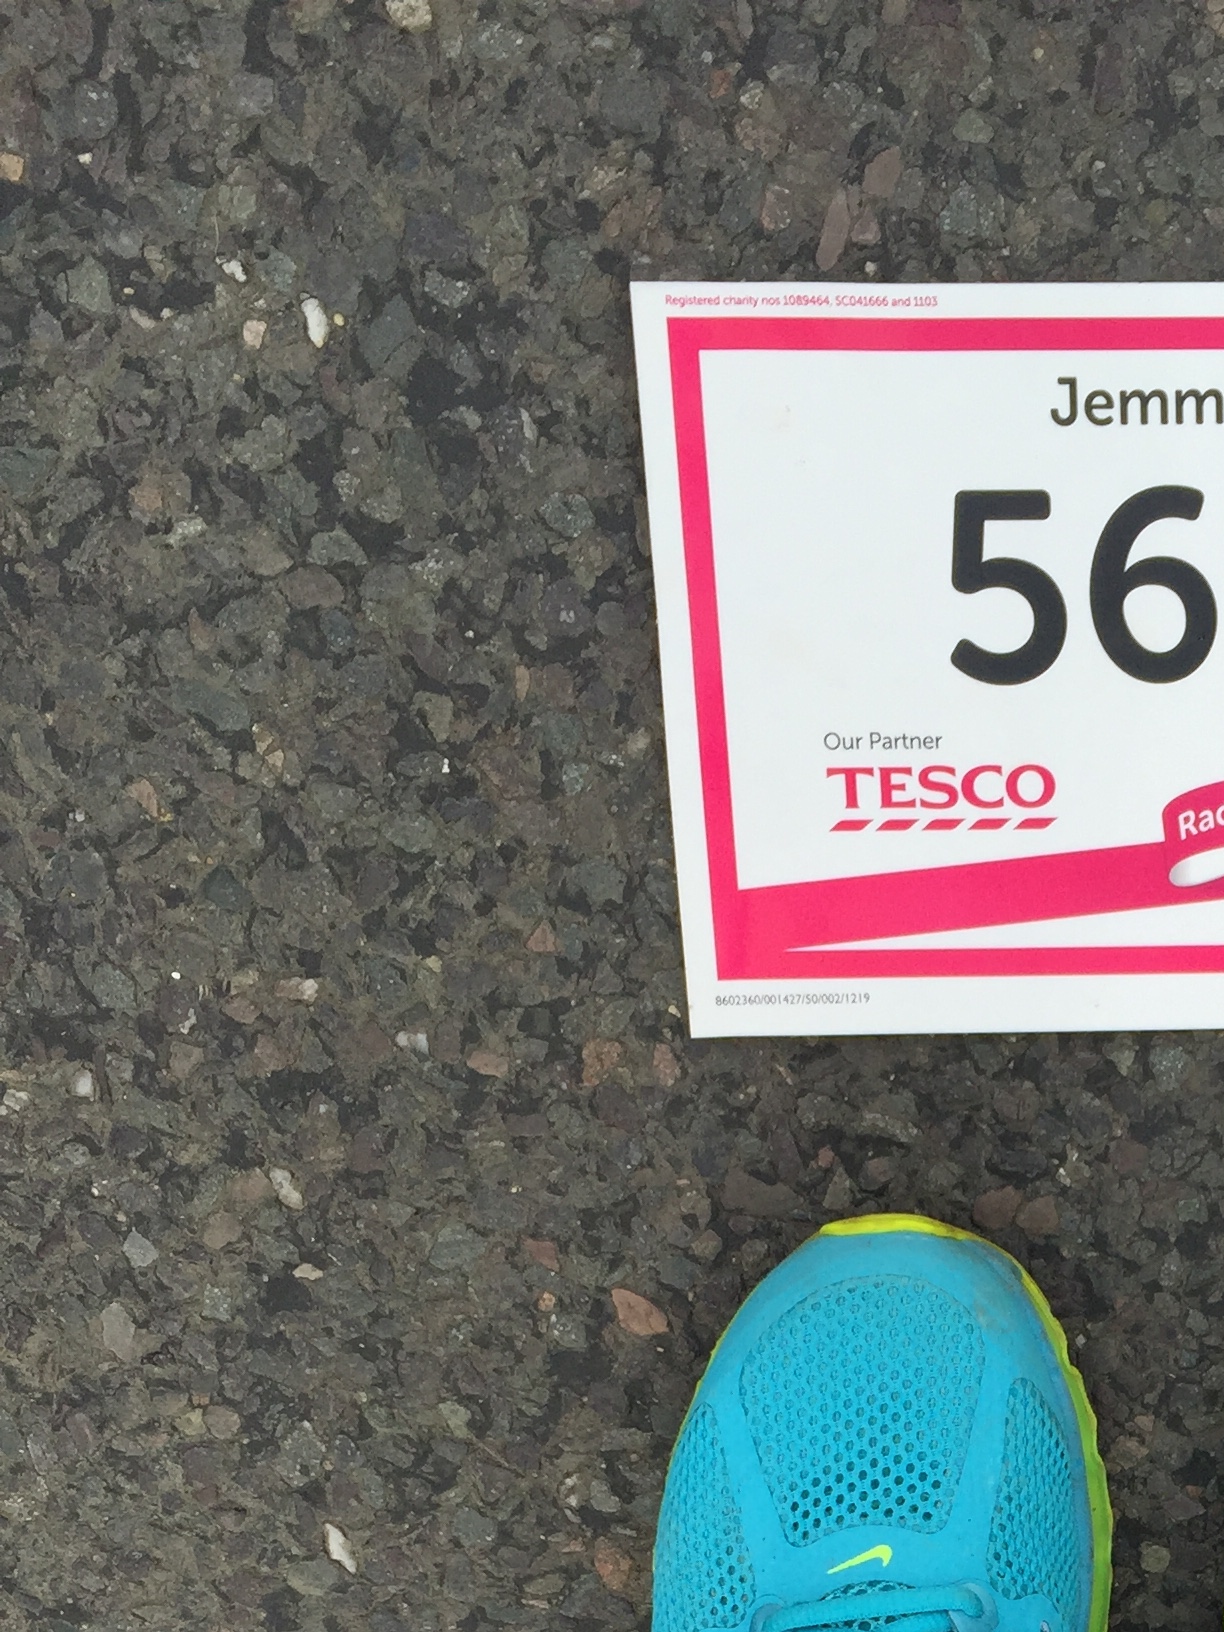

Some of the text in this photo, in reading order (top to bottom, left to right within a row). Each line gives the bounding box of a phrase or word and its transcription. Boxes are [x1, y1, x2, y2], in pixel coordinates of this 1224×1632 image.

[665, 294, 720, 308] Registered
[722, 295, 759, 308] charity
[761, 297, 781, 306] nos
[835, 295, 889, 307] SC041666
[891, 296, 912, 307] and
[914, 296, 938, 307] 1103
[823, 731, 943, 751] Our Partner
[826, 764, 1056, 810] TESCO
